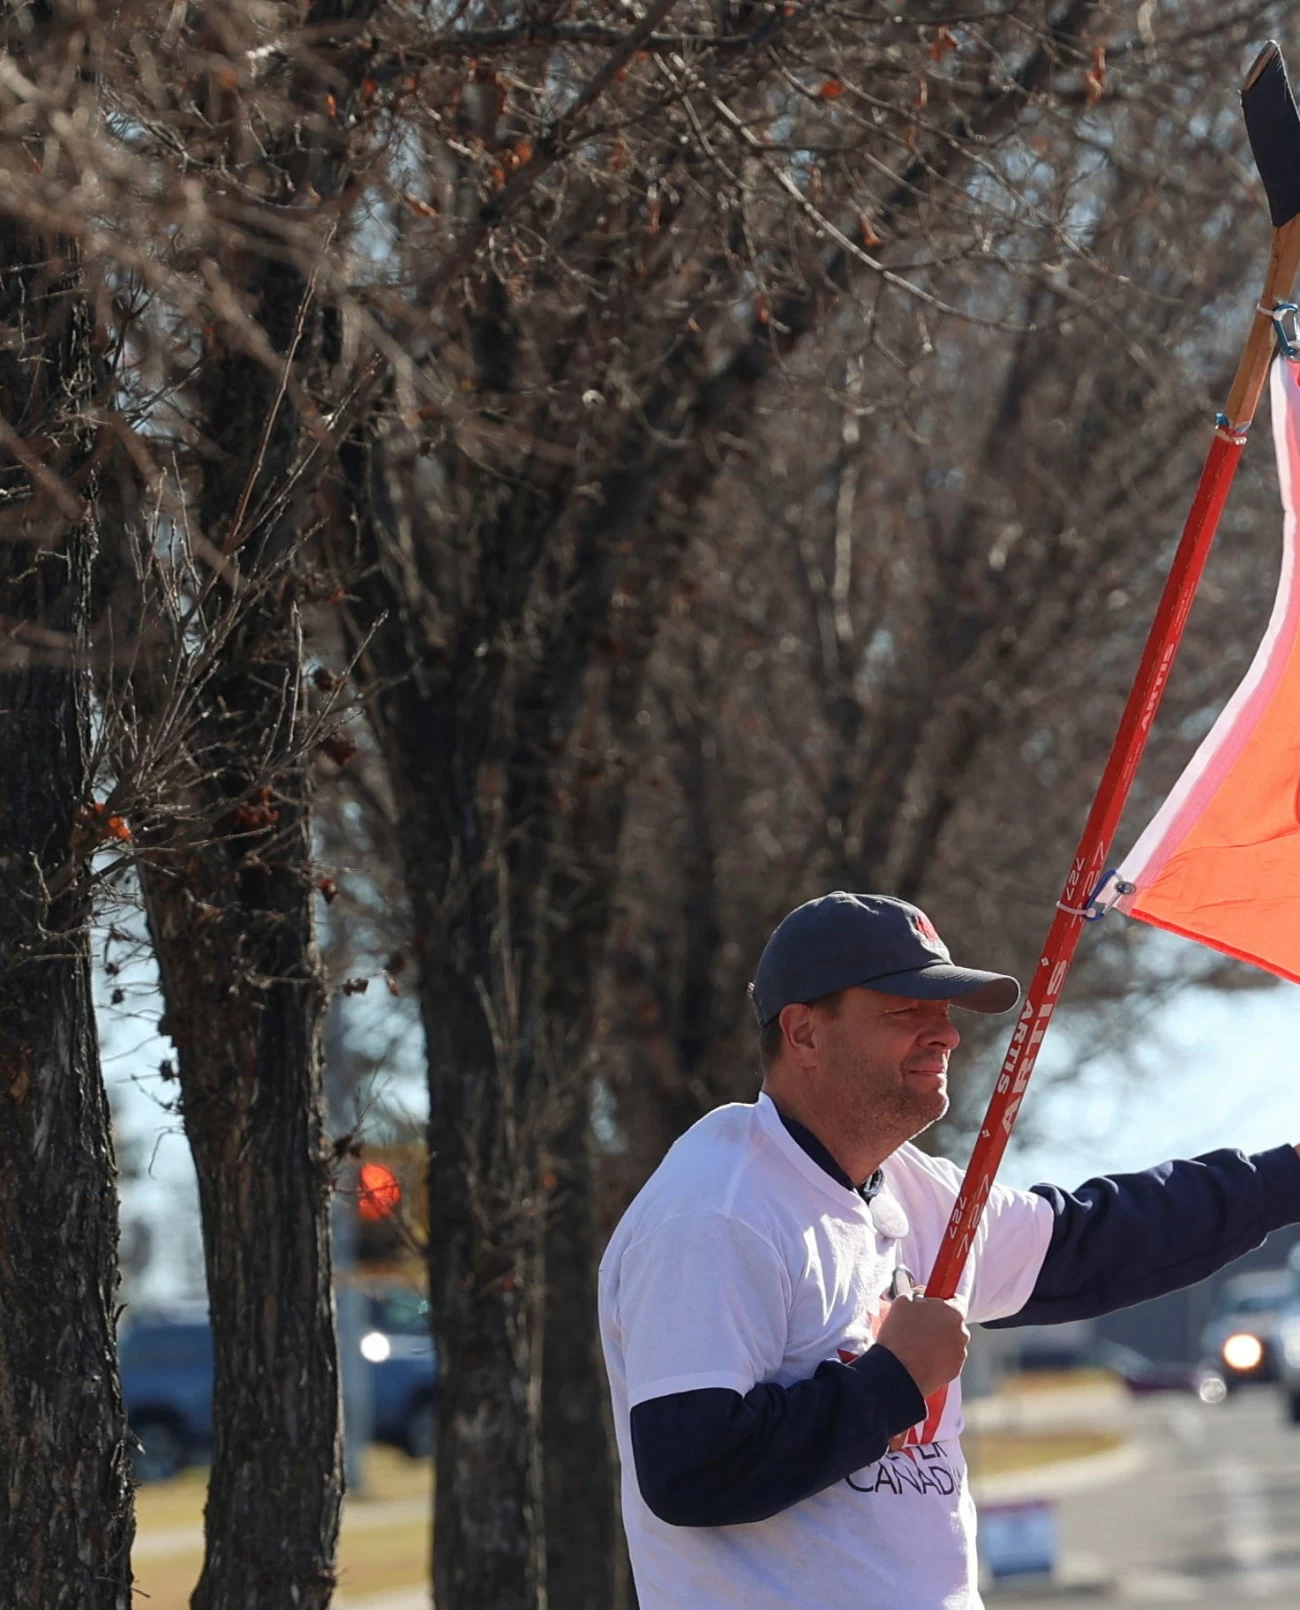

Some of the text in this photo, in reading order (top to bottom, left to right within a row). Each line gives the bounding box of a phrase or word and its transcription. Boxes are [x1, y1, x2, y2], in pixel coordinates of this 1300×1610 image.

[1140, 643, 1174, 731] ARTIS
[1066, 857, 1086, 901] 727
[997, 999, 1034, 1095] ARTIS
[1001, 959, 1068, 1135] ARTIS
[948, 1196, 968, 1240] 727
